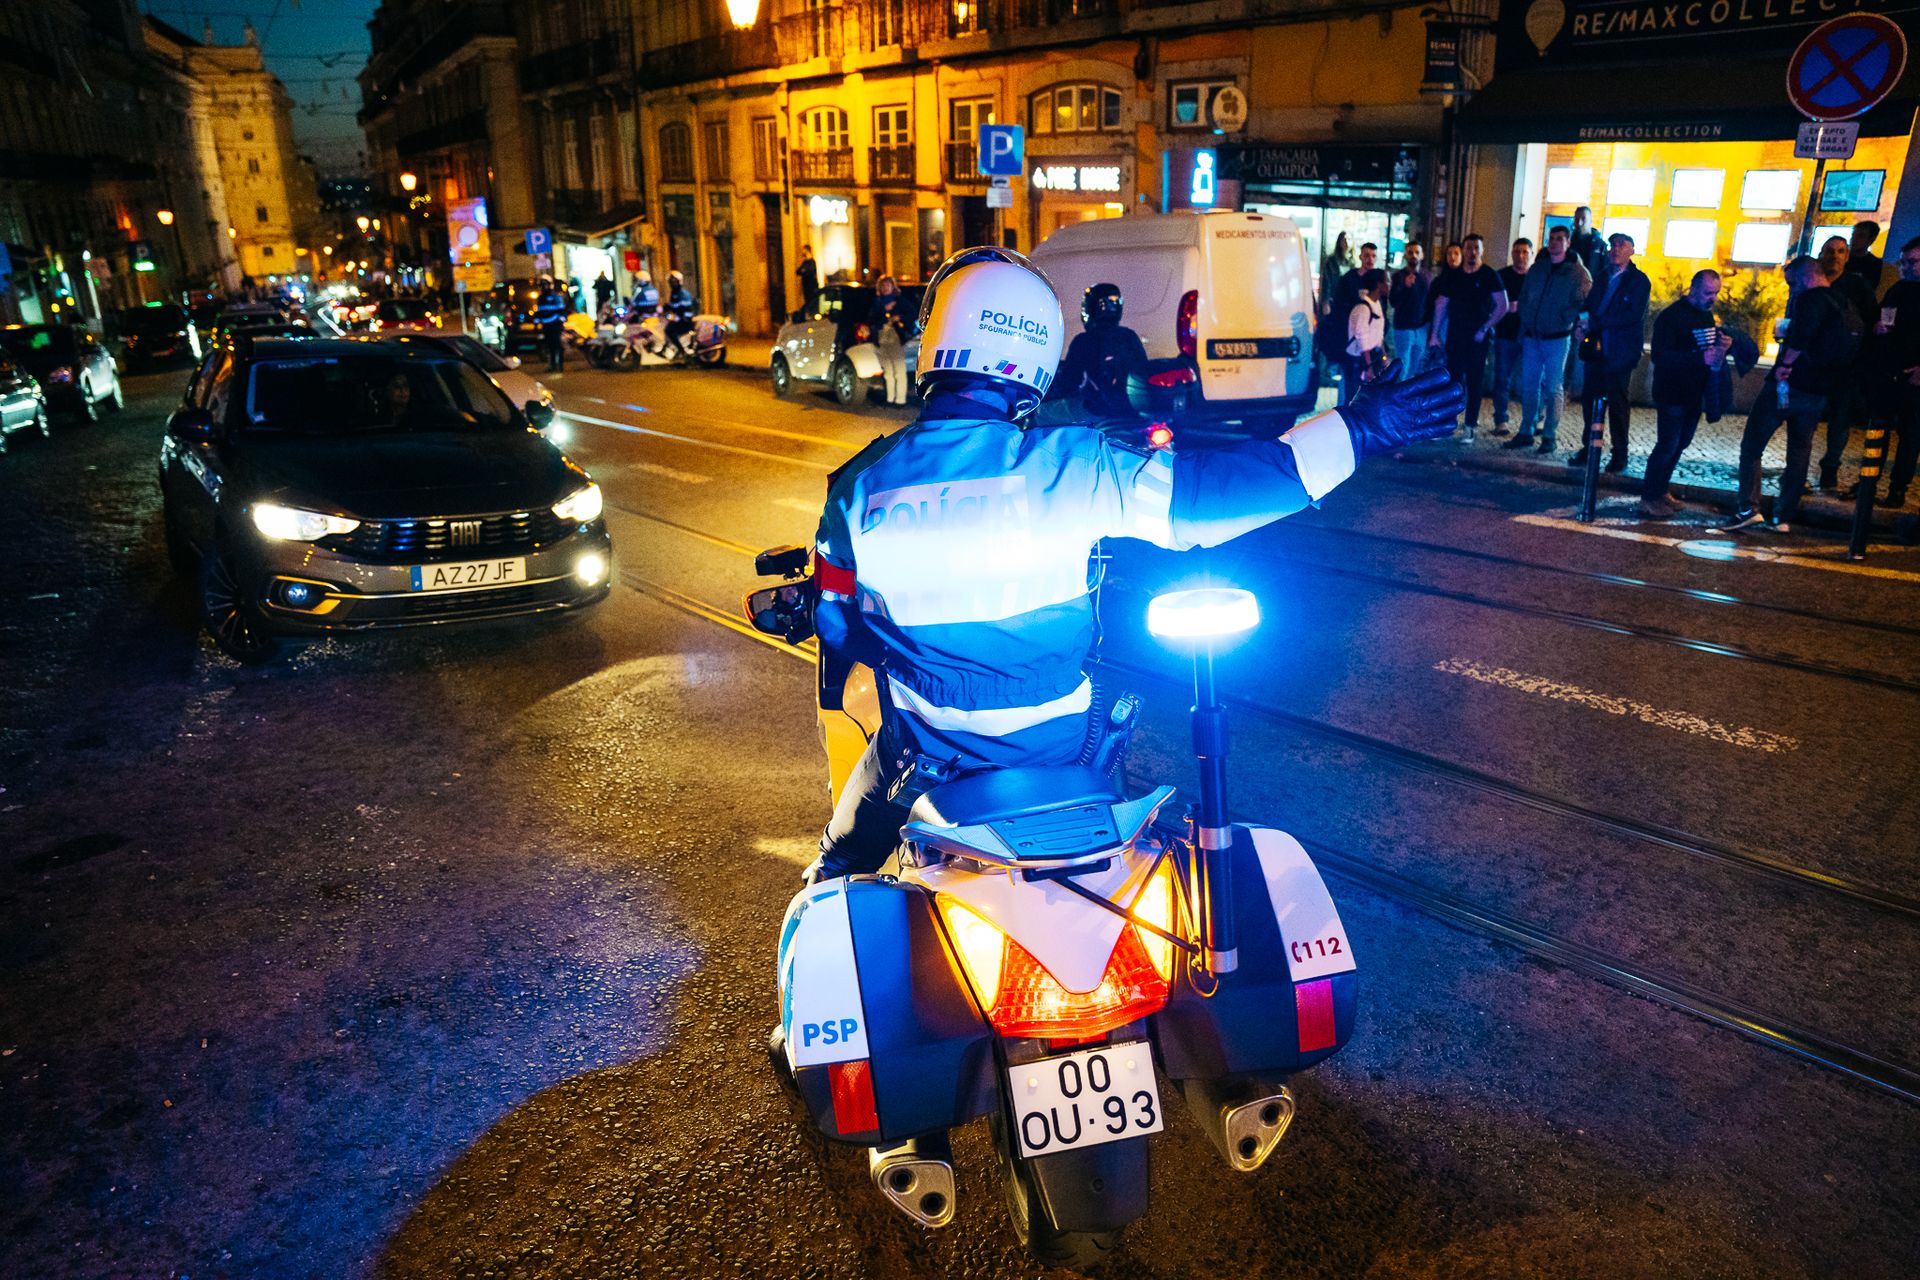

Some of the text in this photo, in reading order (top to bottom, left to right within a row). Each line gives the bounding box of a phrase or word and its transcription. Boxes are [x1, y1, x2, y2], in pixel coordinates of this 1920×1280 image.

[990, 130, 1013, 168] P
[531, 232, 545, 252] P
[981, 310, 1048, 338] POLÍCIA
[450, 521, 483, 545] FIAT
[433, 566, 462, 587] AZ
[466, 563, 488, 583] 27
[493, 561, 515, 580] JF
[1302, 937, 1342, 958] 112
[803, 1018, 858, 1047] PSP
